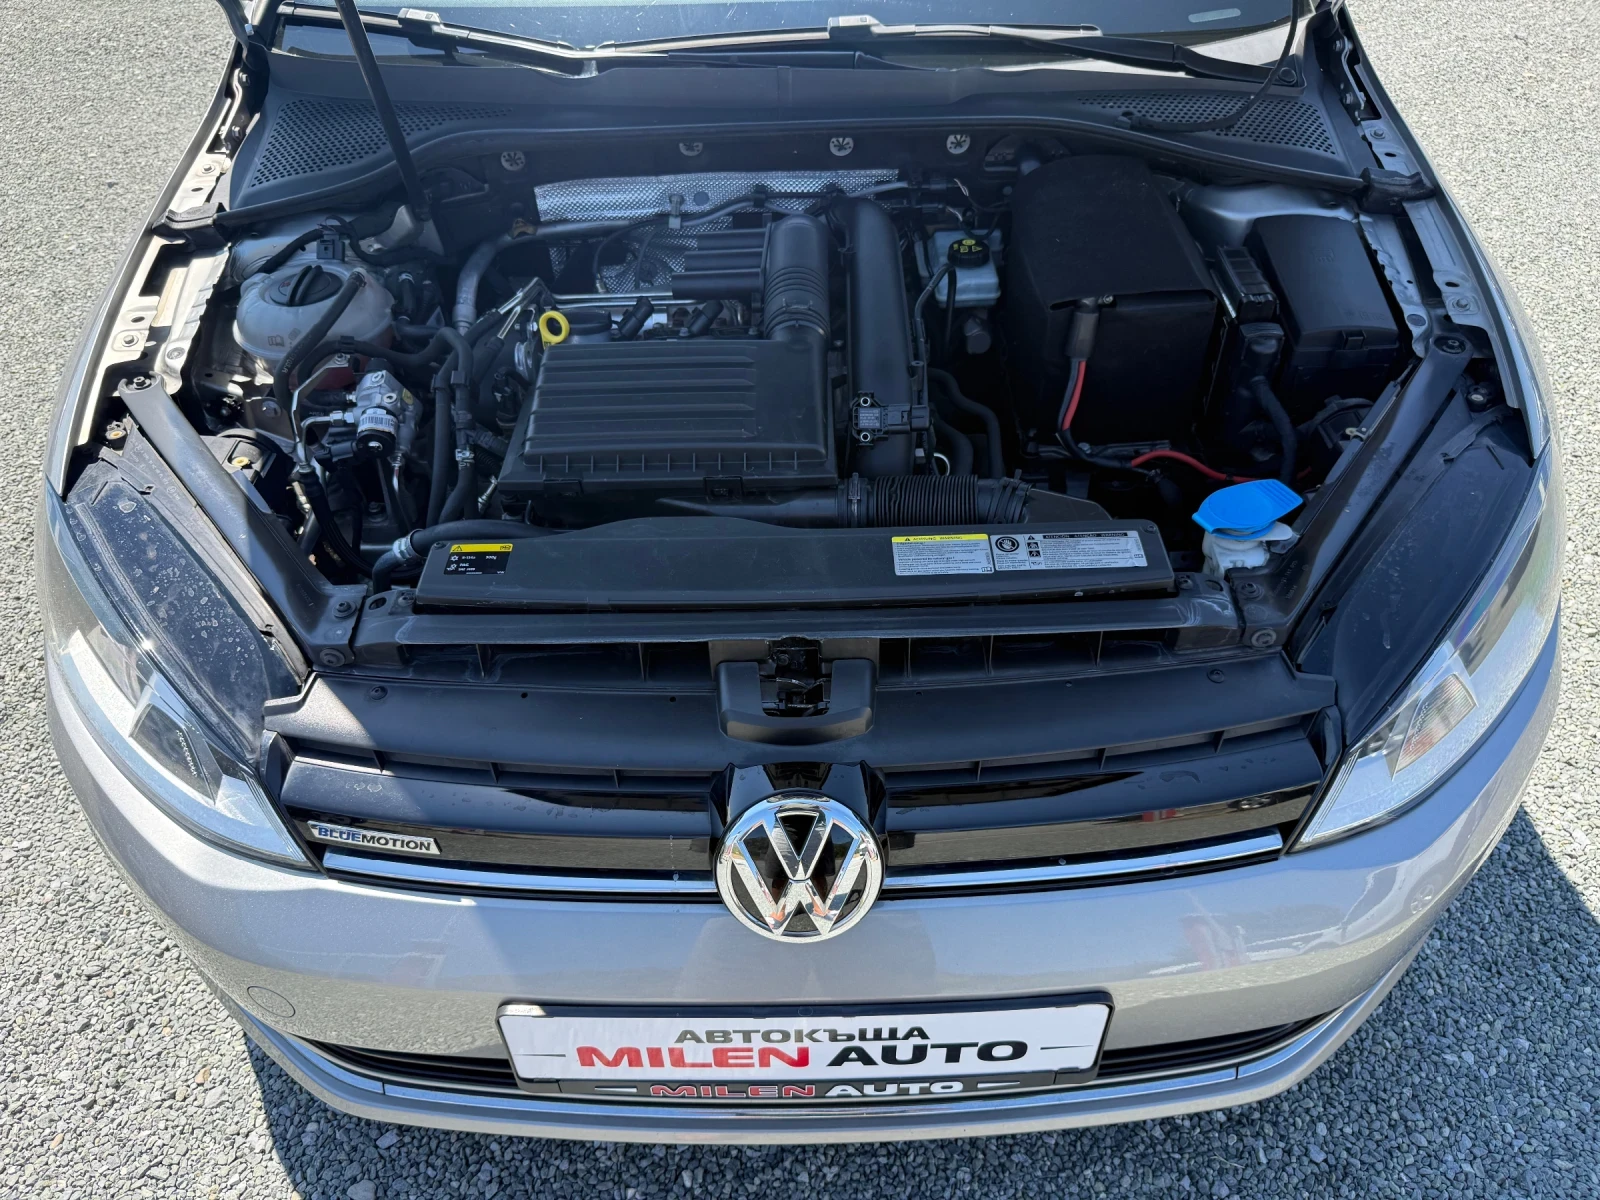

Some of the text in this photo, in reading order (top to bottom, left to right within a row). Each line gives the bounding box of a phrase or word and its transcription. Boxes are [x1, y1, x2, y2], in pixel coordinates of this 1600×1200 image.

[317, 825, 432, 852] BLUEMOTION
[718, 796, 880, 942] VW
[674, 1025, 931, 1044] АВТОКЪША
[576, 1040, 1028, 1068] MILEN AUTO
[649, 1081, 963, 1098] MILEN AUTO
